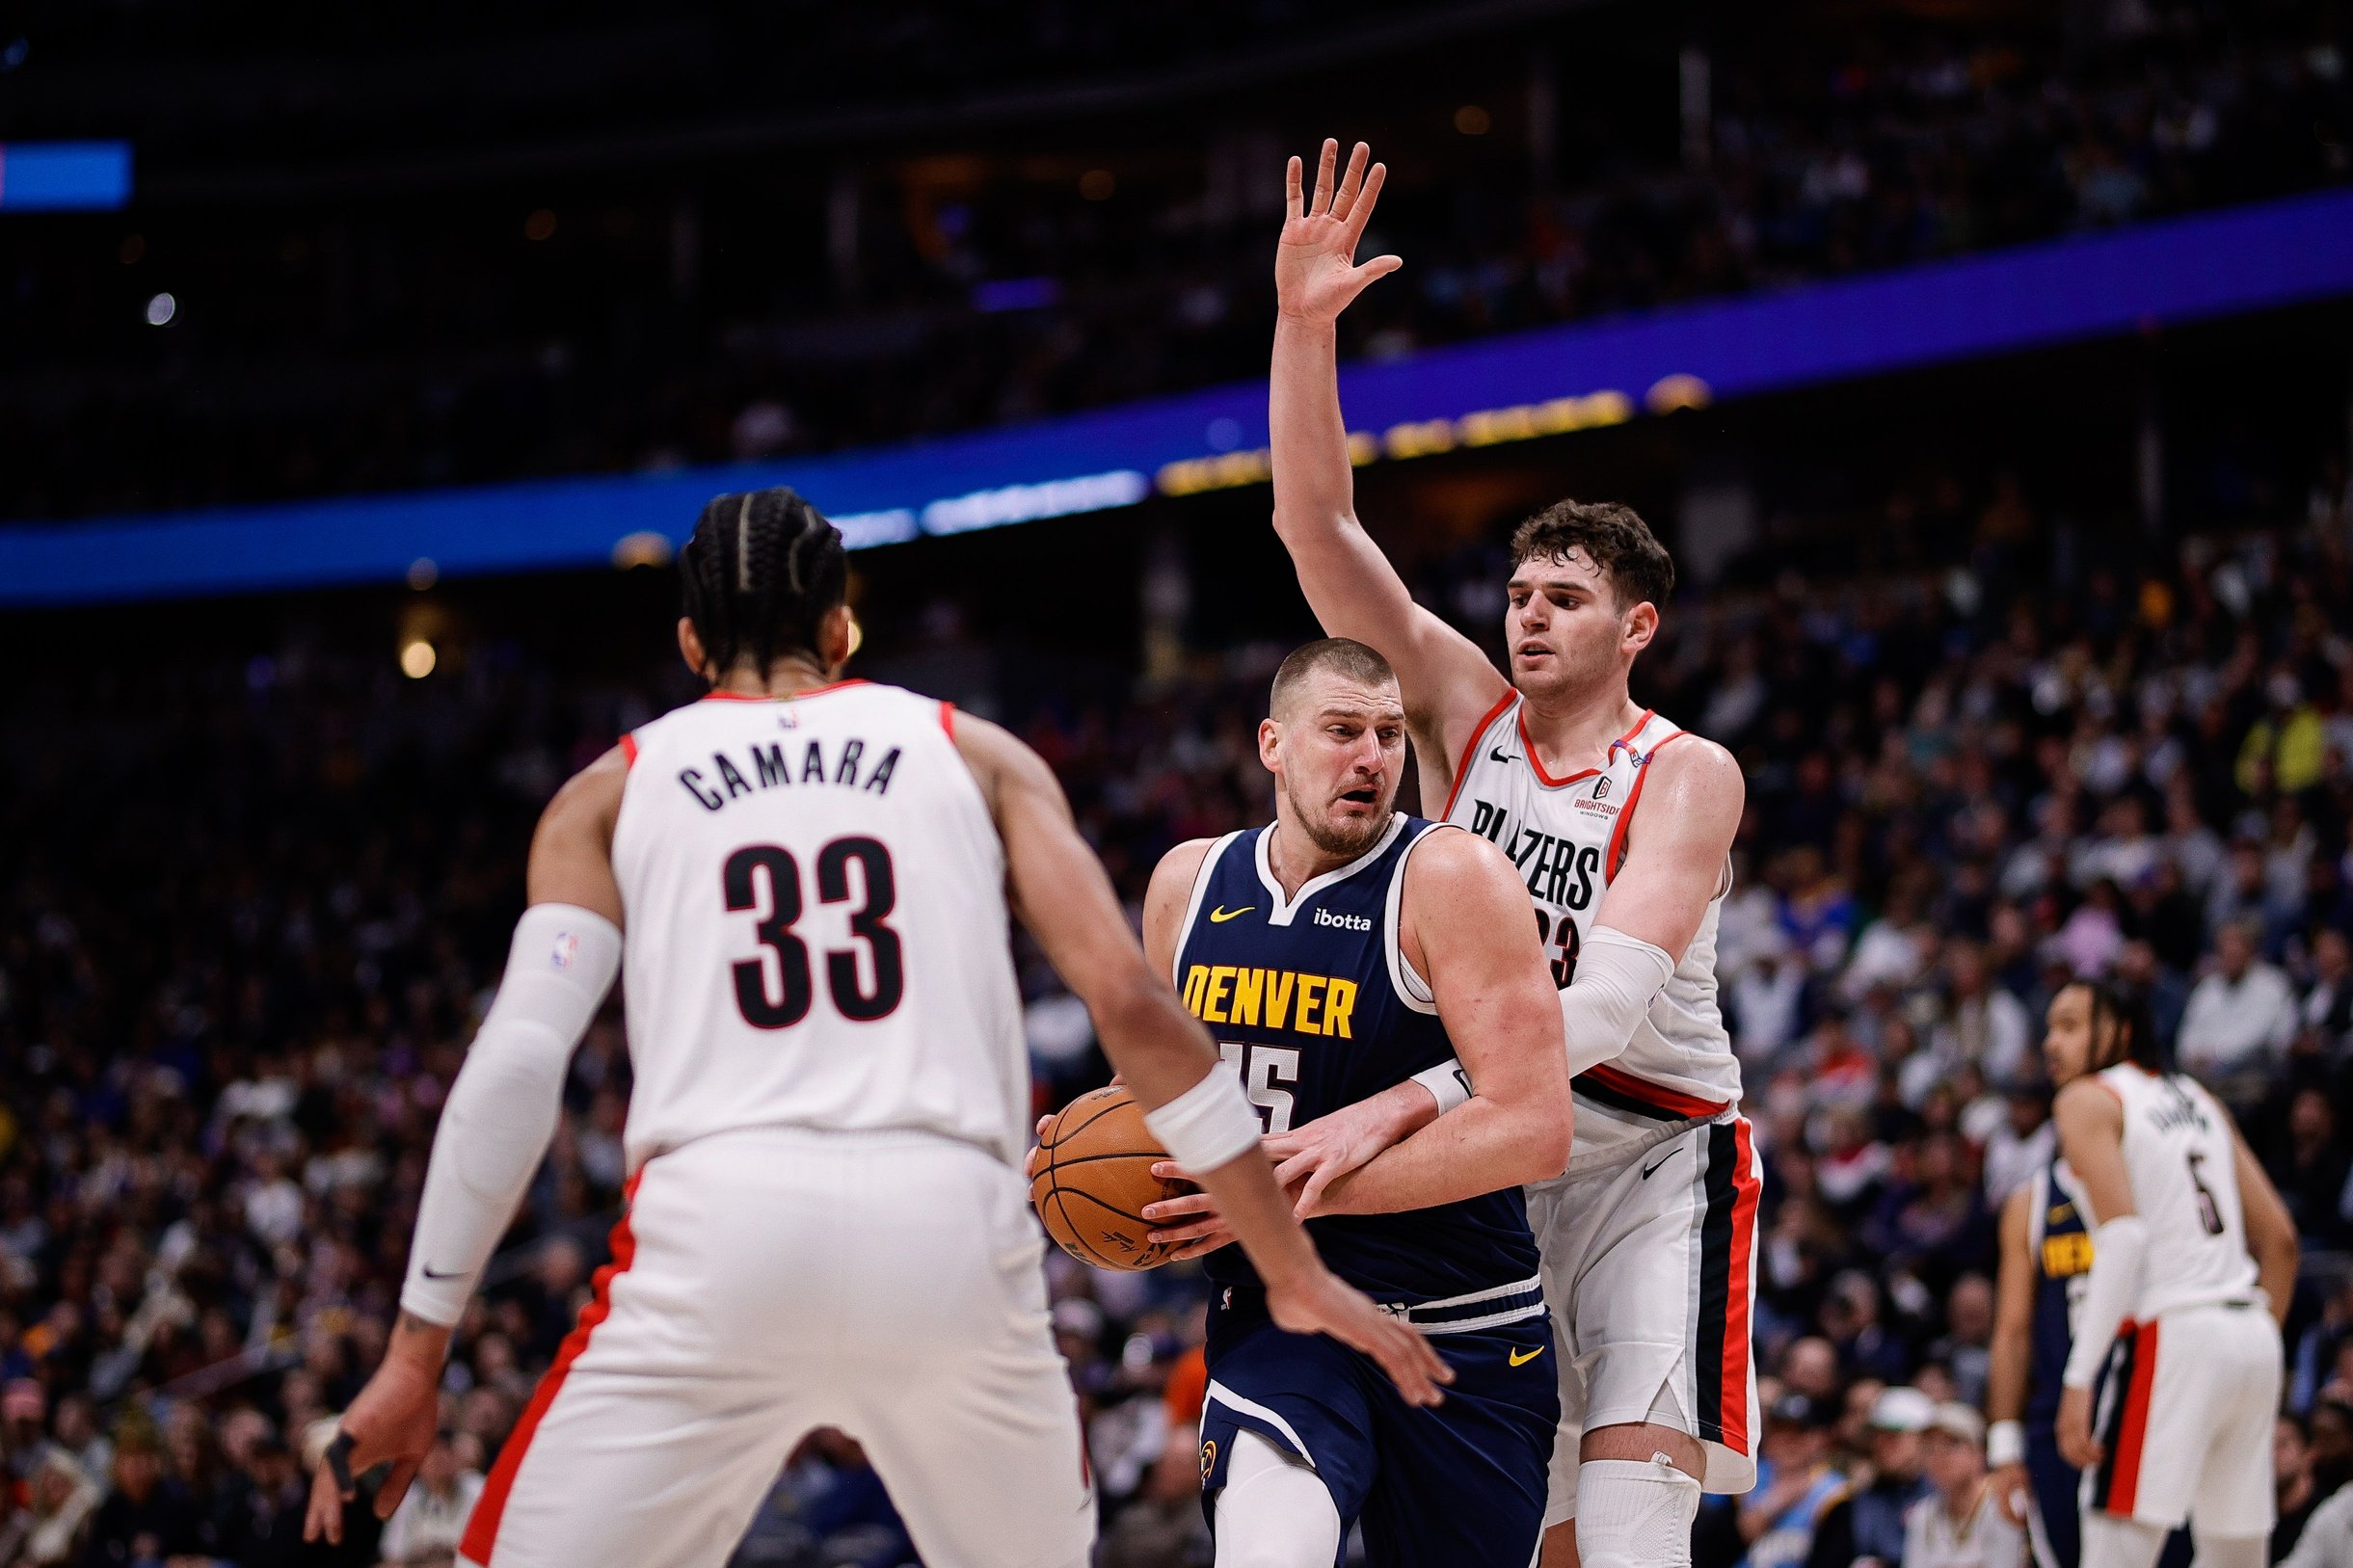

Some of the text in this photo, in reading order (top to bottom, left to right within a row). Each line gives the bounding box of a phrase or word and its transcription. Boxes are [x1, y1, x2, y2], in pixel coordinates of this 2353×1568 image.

[680, 740, 902, 811] CAMARA
[1579, 811, 1609, 820] WINDOWS
[722, 836, 904, 1030] 33
[1313, 908, 1372, 931] ibotta
[1182, 965, 1359, 1039] DENVER
